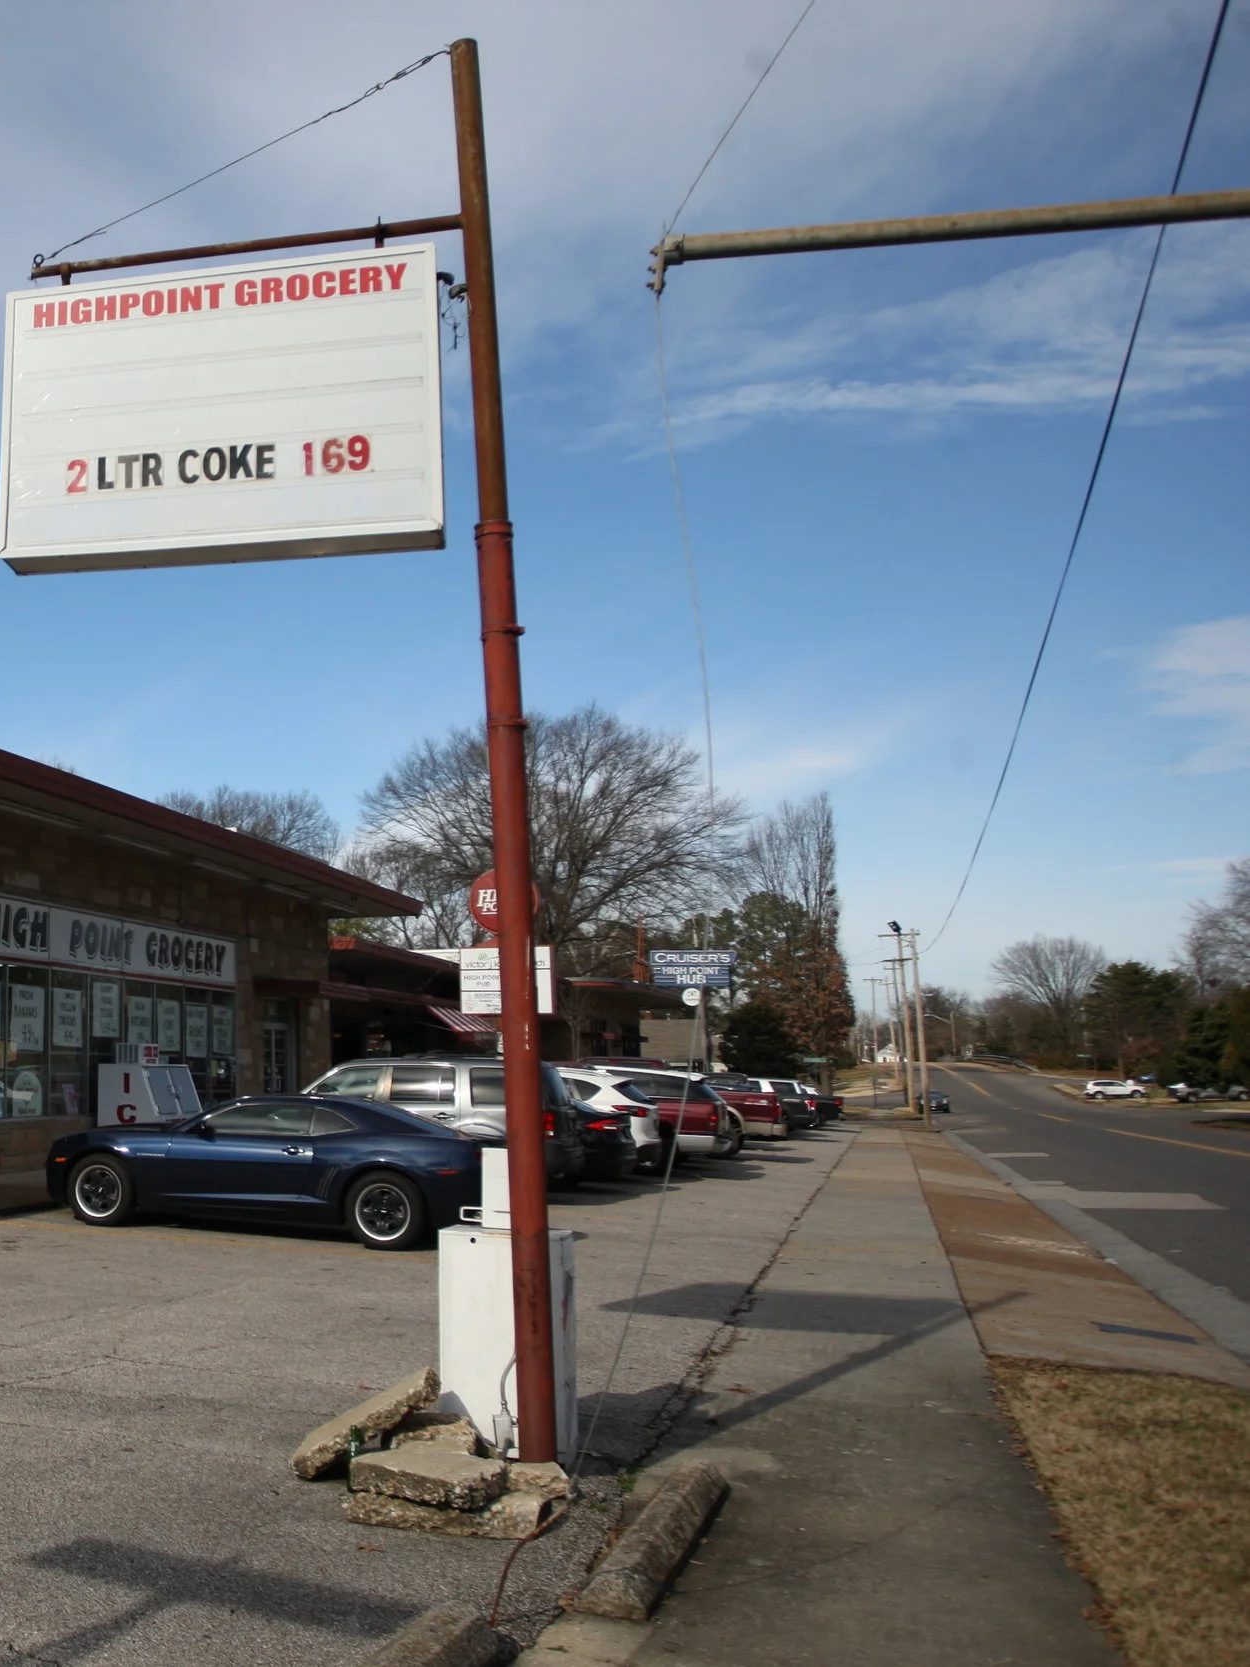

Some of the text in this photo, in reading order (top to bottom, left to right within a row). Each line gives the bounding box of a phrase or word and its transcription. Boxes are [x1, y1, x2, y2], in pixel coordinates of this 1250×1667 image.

[33, 262, 408, 329] HIGHPOINT GROCERY
[67, 434, 371, 494] 2 LTR COKE 169
[476, 888, 497, 907] HI
[69, 918, 135, 966] POINT
[146, 931, 227, 977] GROCERY
[662, 966, 720, 975] HIGH POINT
[676, 974, 706, 984] HUB
[14, 1005, 38, 1019] BANANAS
